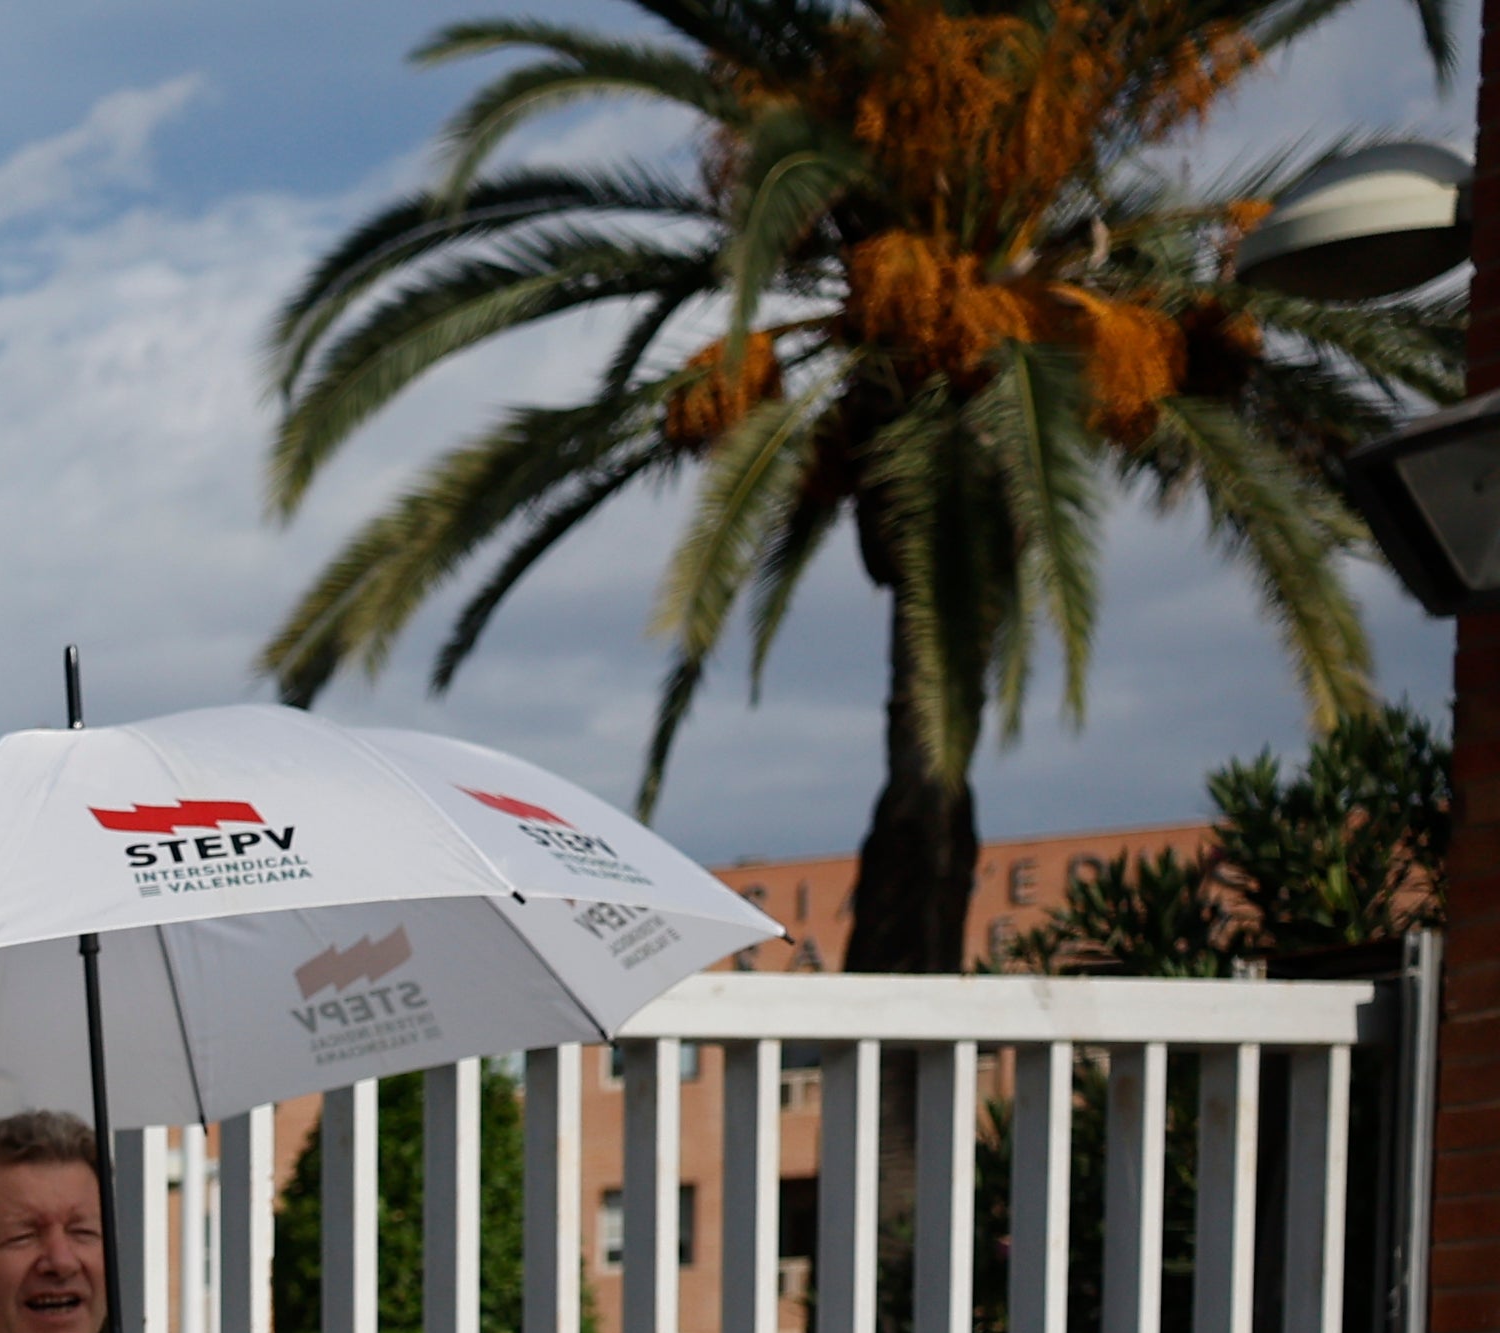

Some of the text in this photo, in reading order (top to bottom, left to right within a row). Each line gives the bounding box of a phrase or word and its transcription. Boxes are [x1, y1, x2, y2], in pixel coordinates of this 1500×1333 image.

[125, 826, 295, 867] STEPV
[135, 854, 308, 883] INTERSINDICAL
[168, 866, 314, 895] VALENCIANA
